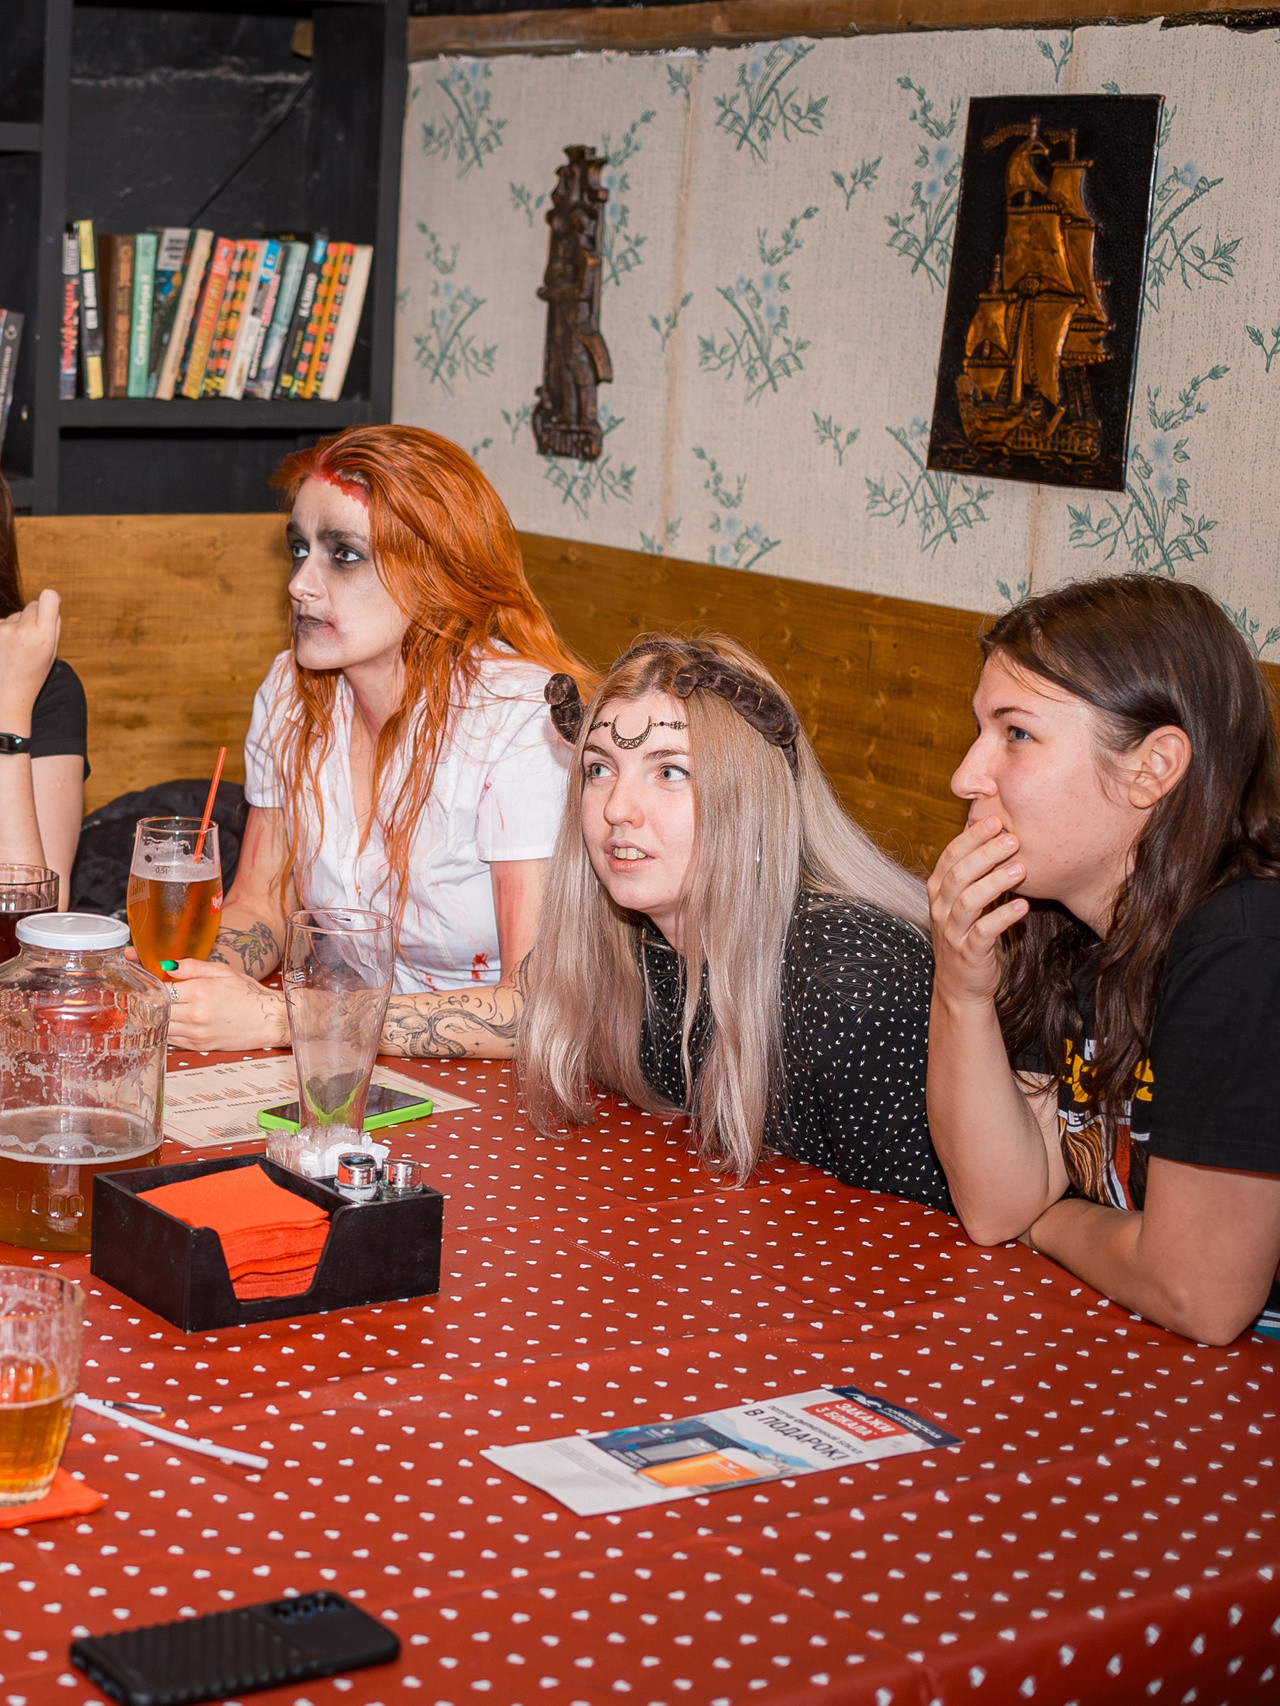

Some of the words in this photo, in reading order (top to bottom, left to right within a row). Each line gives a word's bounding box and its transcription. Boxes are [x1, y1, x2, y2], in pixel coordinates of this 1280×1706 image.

[743, 1408, 764, 1417] В
[757, 1415, 850, 1461] ПОДАРОК!
[835, 1402, 896, 1433] ЗАКАЖИ
